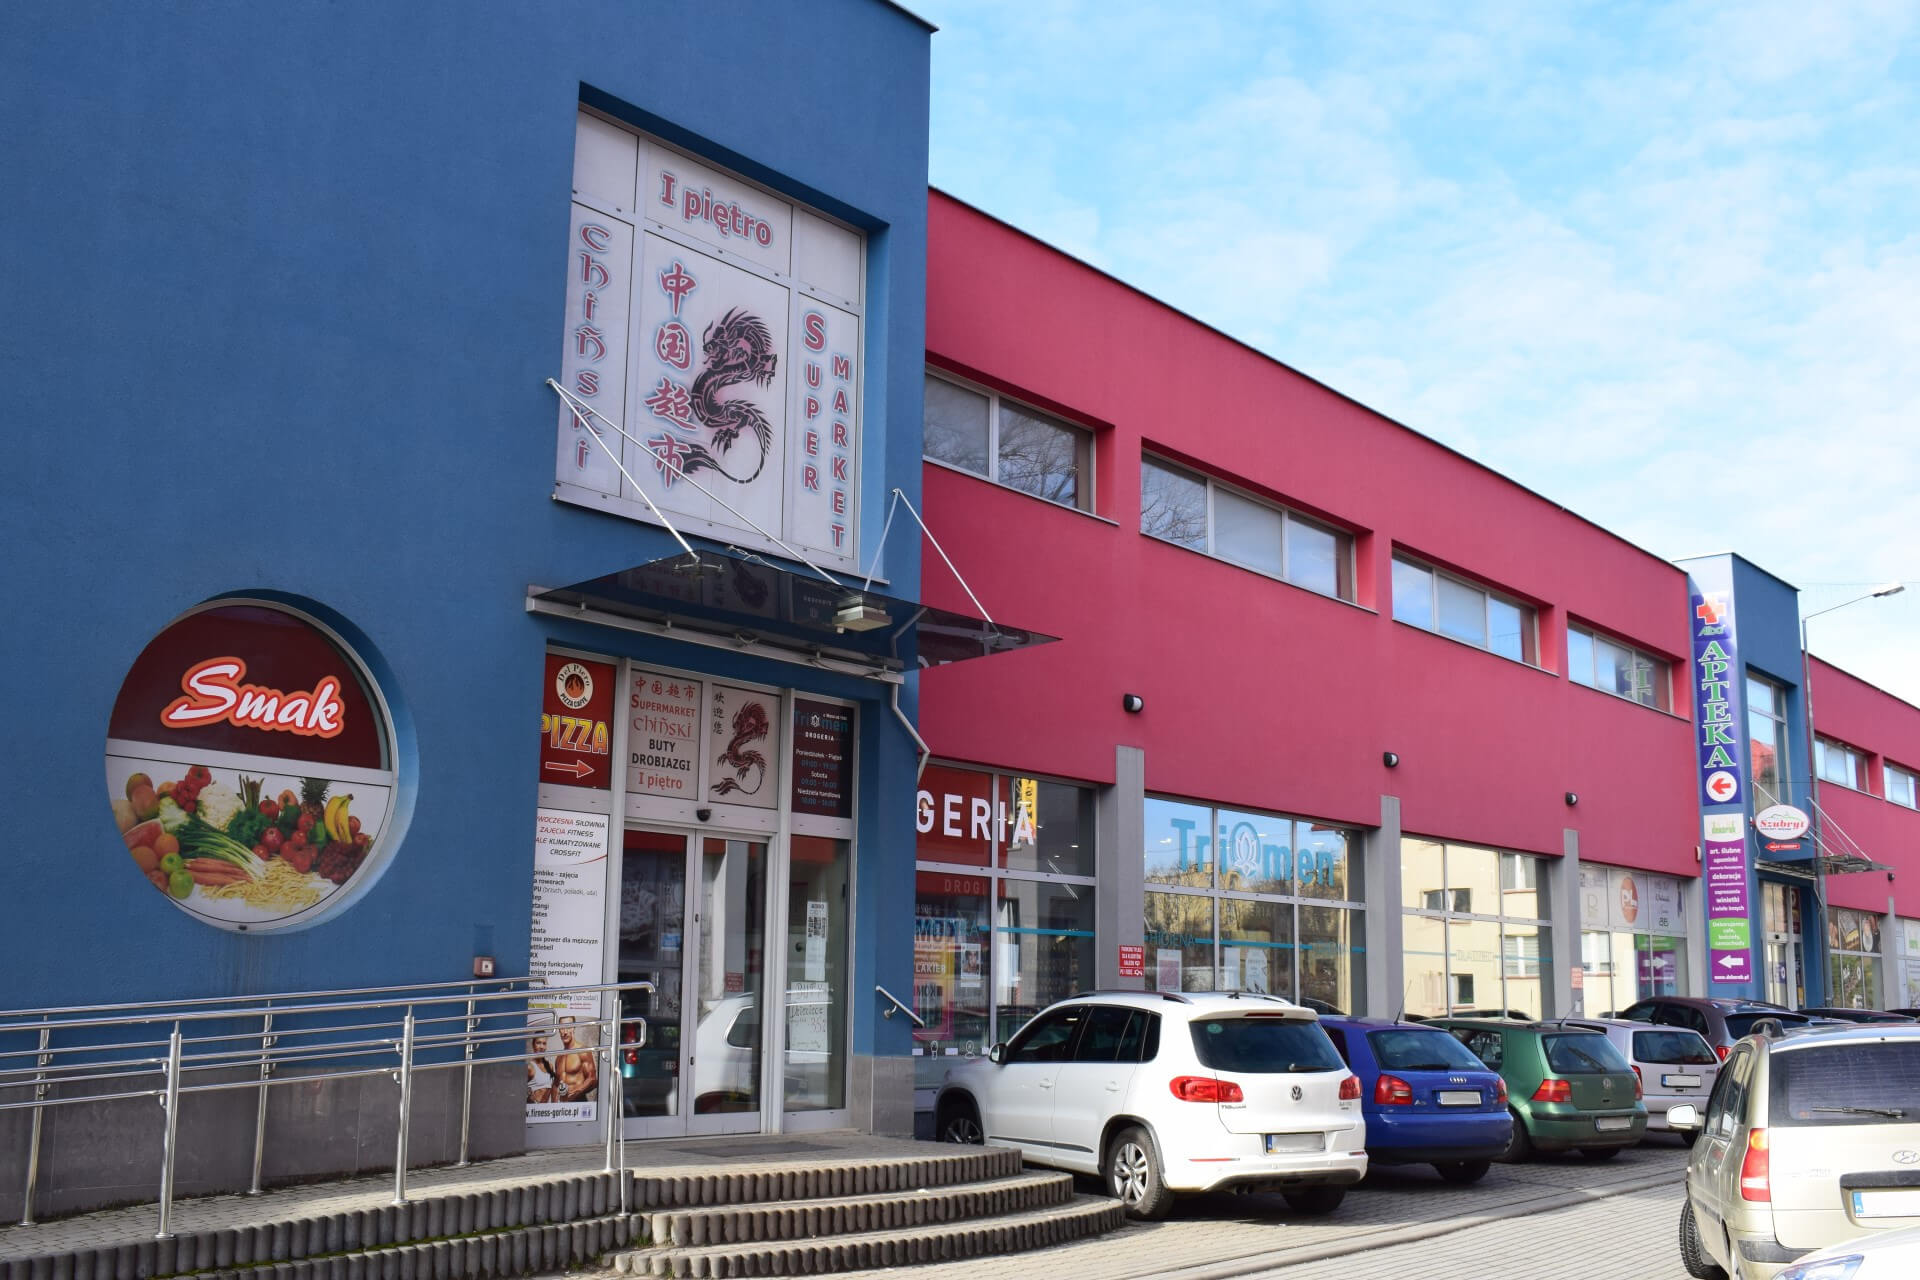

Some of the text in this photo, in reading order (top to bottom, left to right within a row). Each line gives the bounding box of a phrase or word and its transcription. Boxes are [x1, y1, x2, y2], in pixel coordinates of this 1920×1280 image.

[661, 172, 773, 246] I piętro
[644, 261, 697, 488] 中国超市
[803, 313, 825, 490] SUPER
[832, 355, 850, 547] MARKET
[163, 658, 343, 736] Smak
[635, 676, 695, 701] 中国超市
[631, 694, 696, 717] SUPERMARKET
[1698, 640, 1736, 768] APTEKA
[541, 713, 608, 755] PIZZA
[805, 731, 834, 741] DROGERIA
[649, 739, 676, 752] BUTY
[632, 753, 690, 771] DROBIAZGI
[639, 772, 683, 790] I piętro
[811, 771, 828, 779] Sobota
[537, 816, 573, 825] WOCZESNA
[1760, 819, 1804, 829] Szubryt
[549, 838, 601, 848] KLIMATYZOWANE
[548, 961, 583, 970] funkcjonalny
